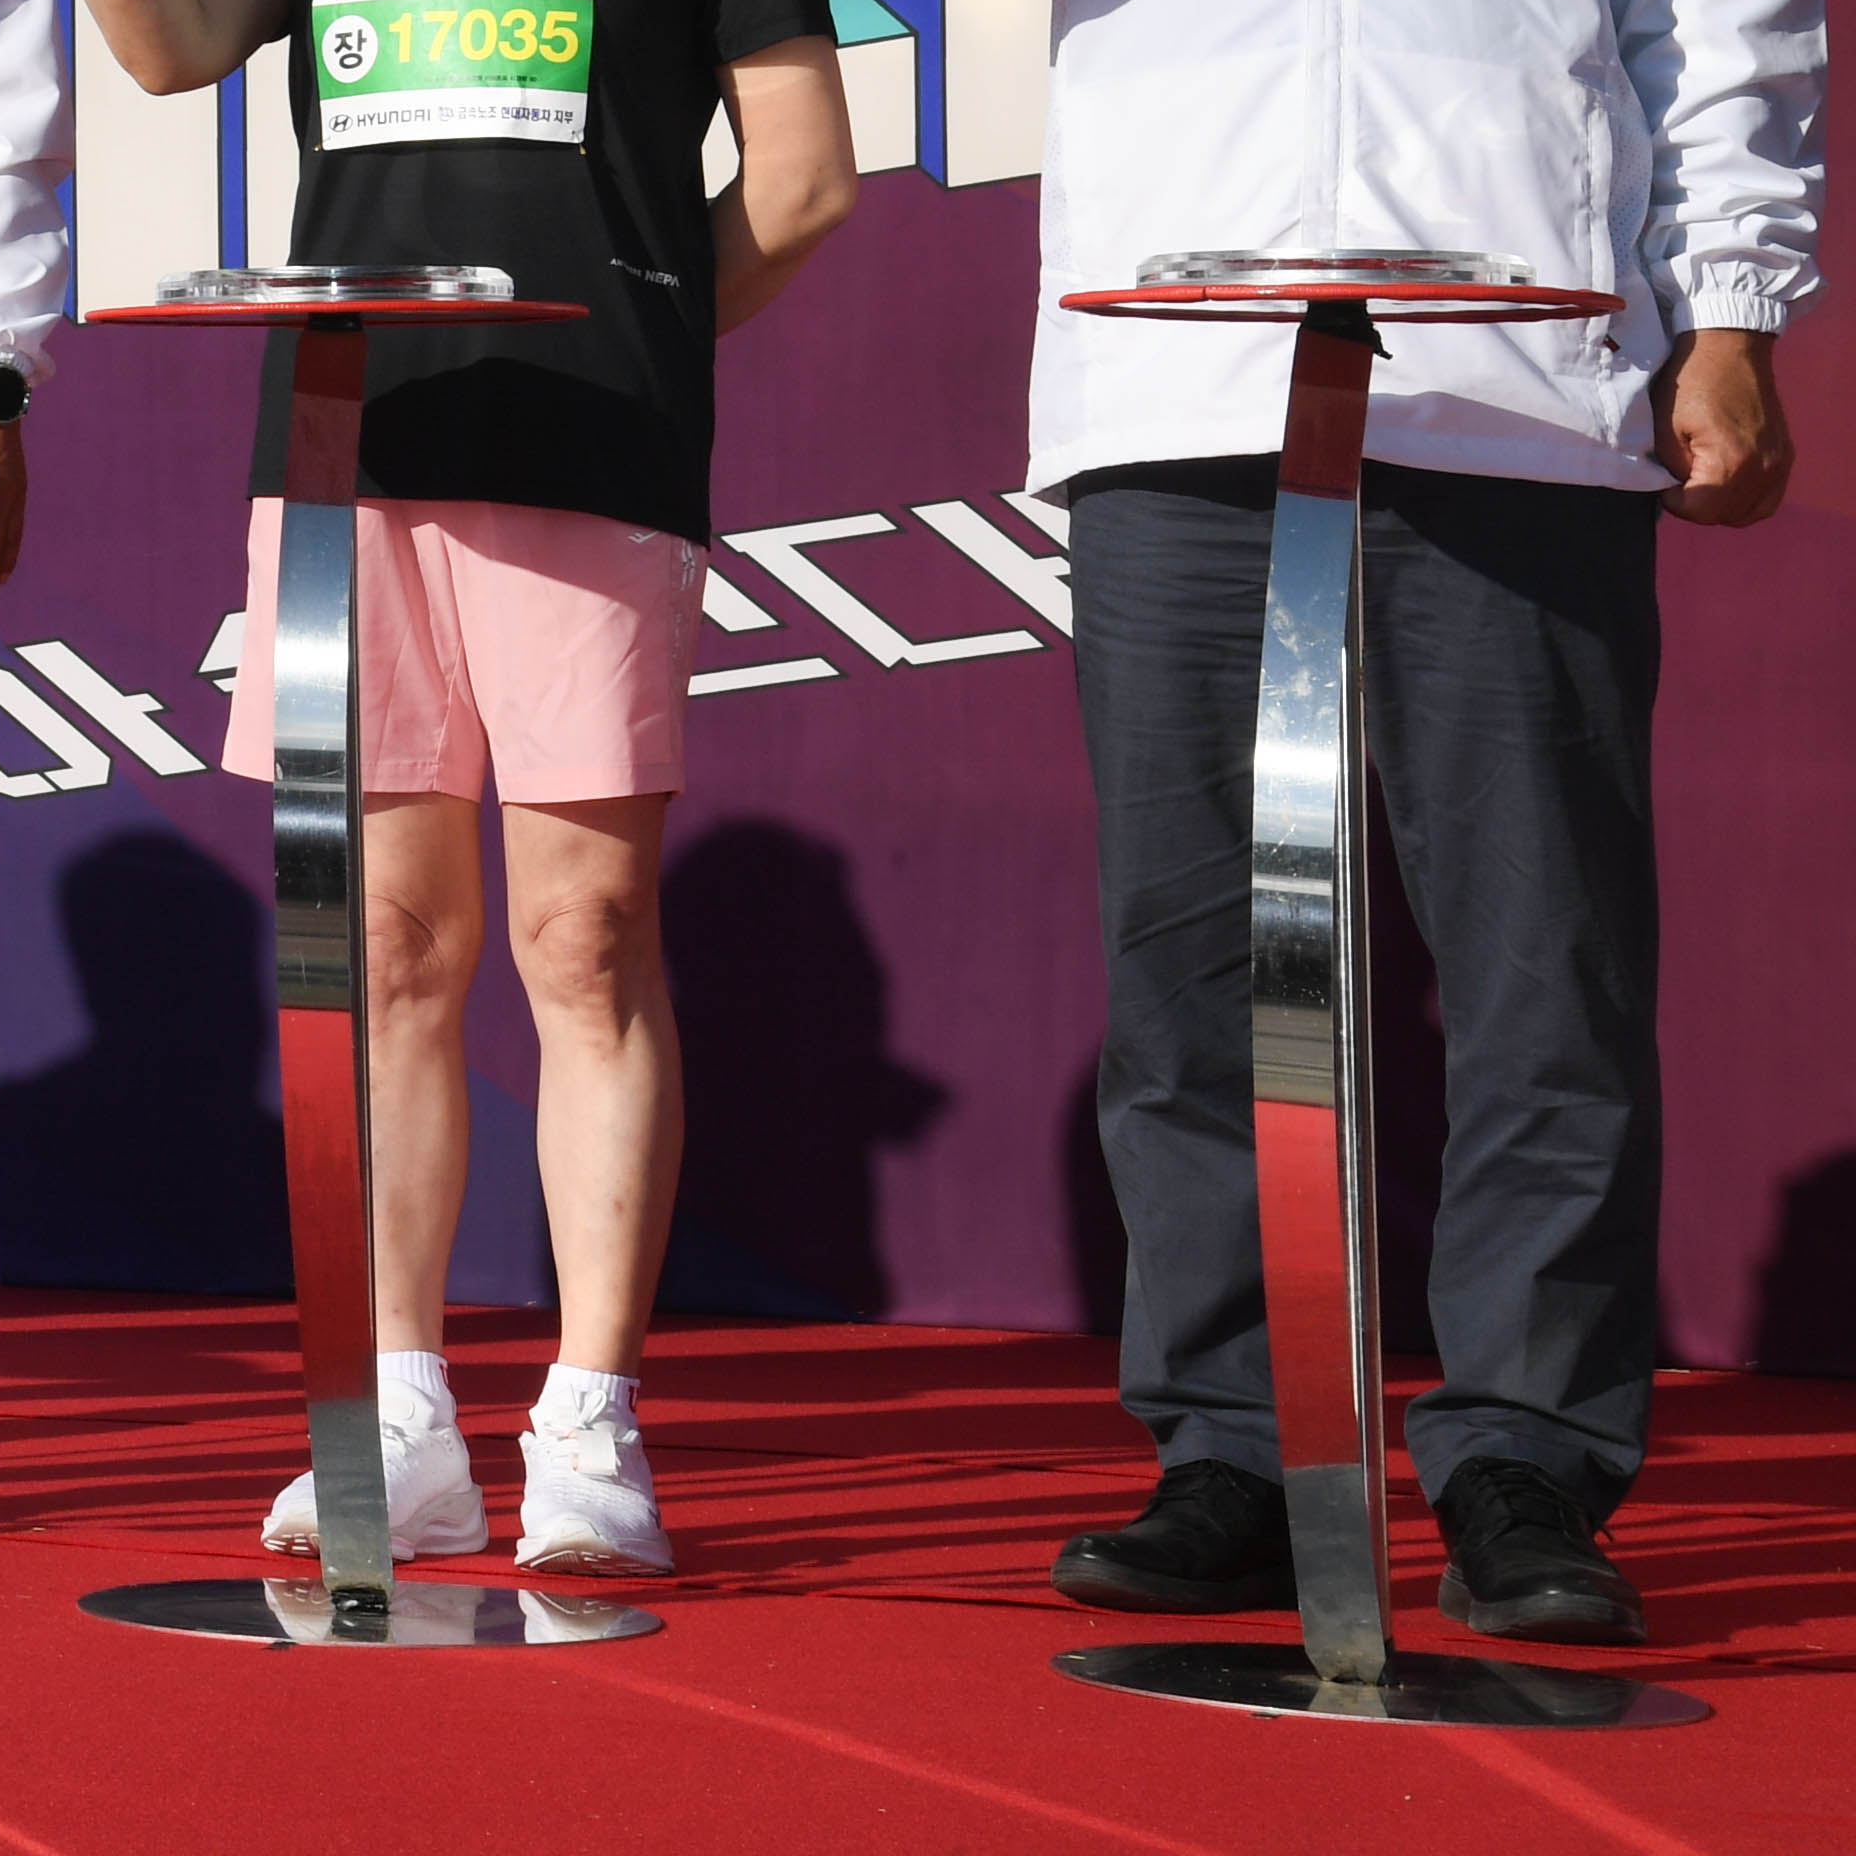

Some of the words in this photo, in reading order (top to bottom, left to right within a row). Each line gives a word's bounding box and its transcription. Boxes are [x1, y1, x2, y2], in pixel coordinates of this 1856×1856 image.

[334, 29, 367, 69] 장
[388, 8, 579, 64] 17035
[357, 109, 431, 128] HYUNDAI
[501, 106, 551, 123] 현대자동차
[554, 110, 573, 124] 지부
[645, 270, 680, 287] NEPA
